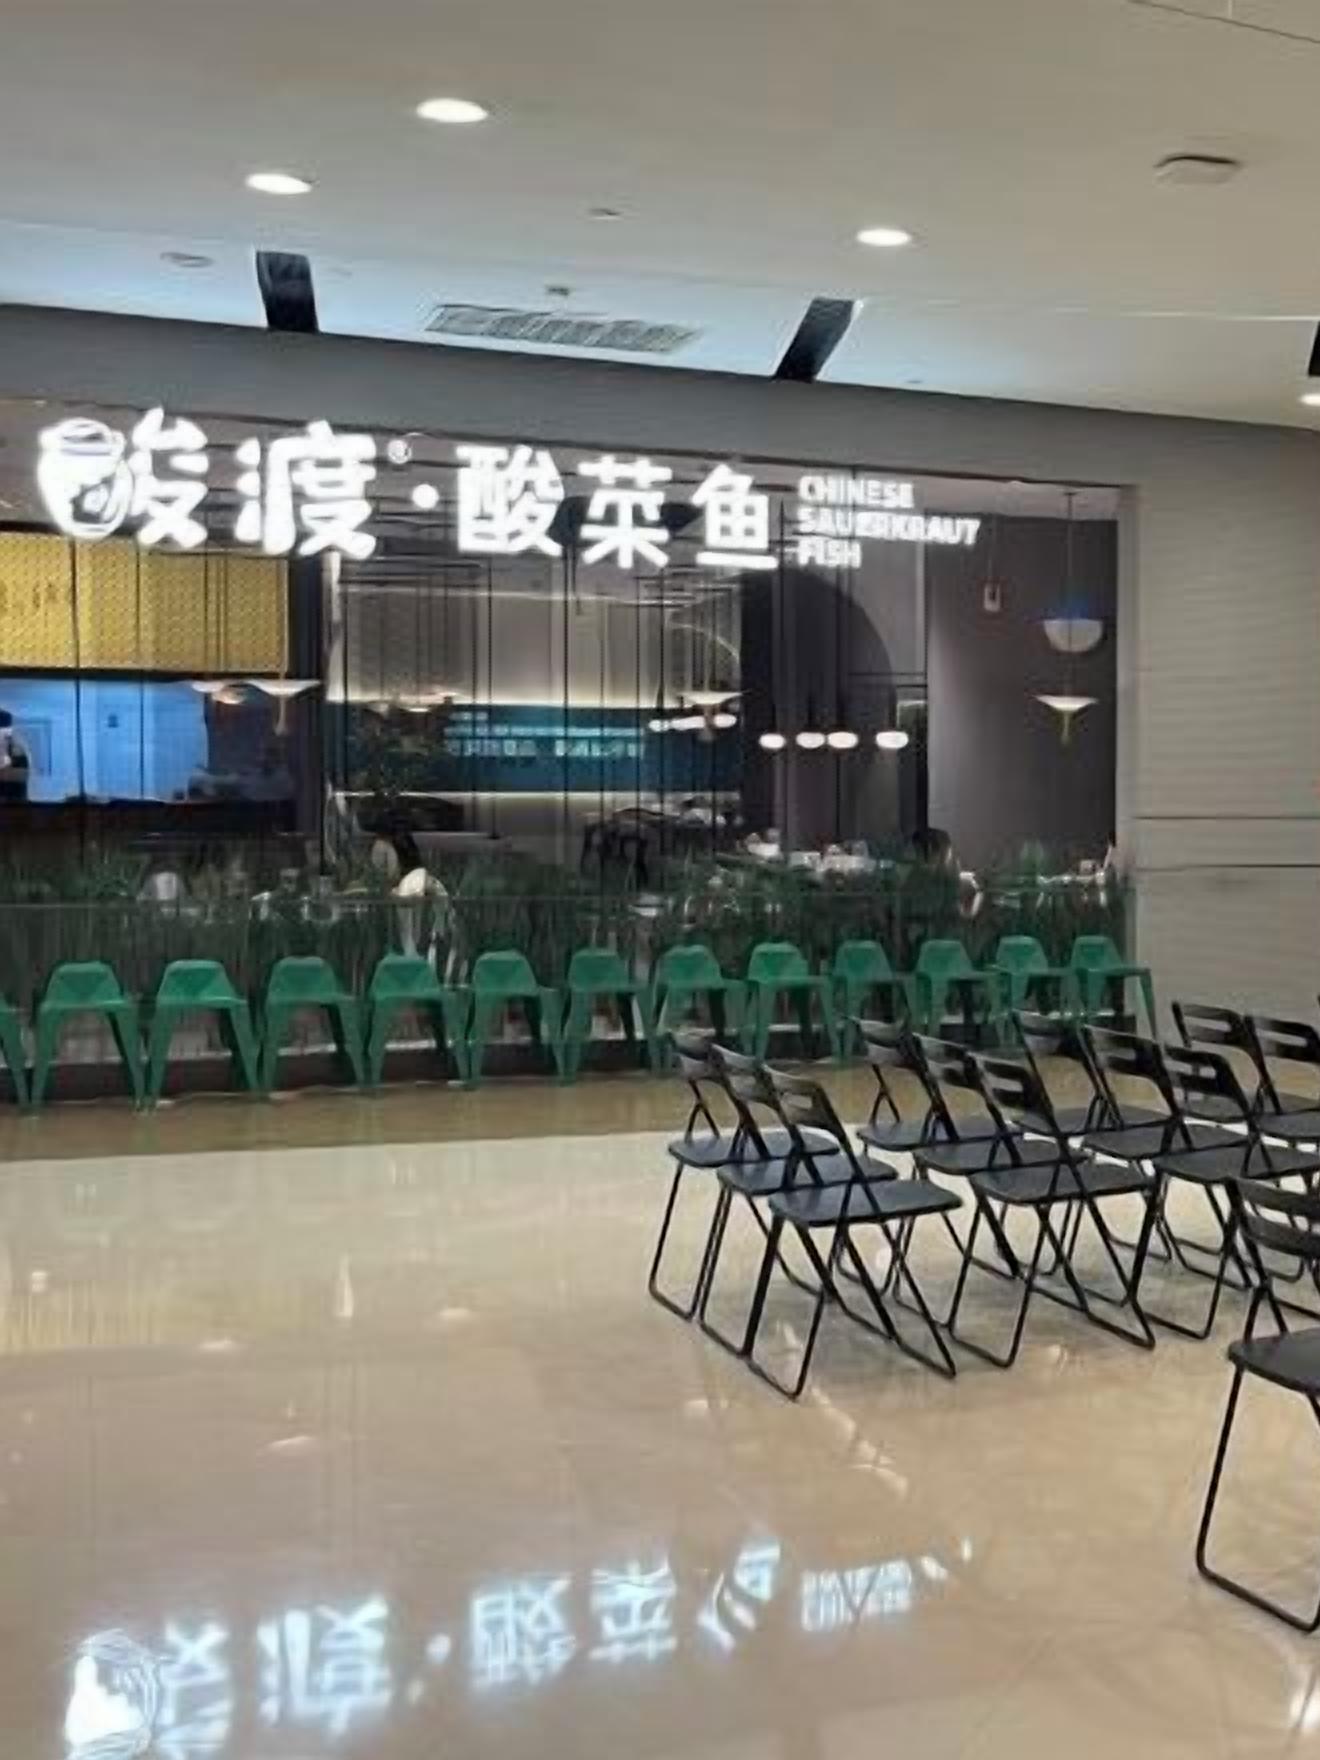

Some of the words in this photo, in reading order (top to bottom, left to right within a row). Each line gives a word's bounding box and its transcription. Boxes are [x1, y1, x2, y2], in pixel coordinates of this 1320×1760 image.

[799, 475, 915, 508] CHINESE
[797, 507, 981, 545] SAUERKRAUT
[797, 538, 862, 569] FISH
